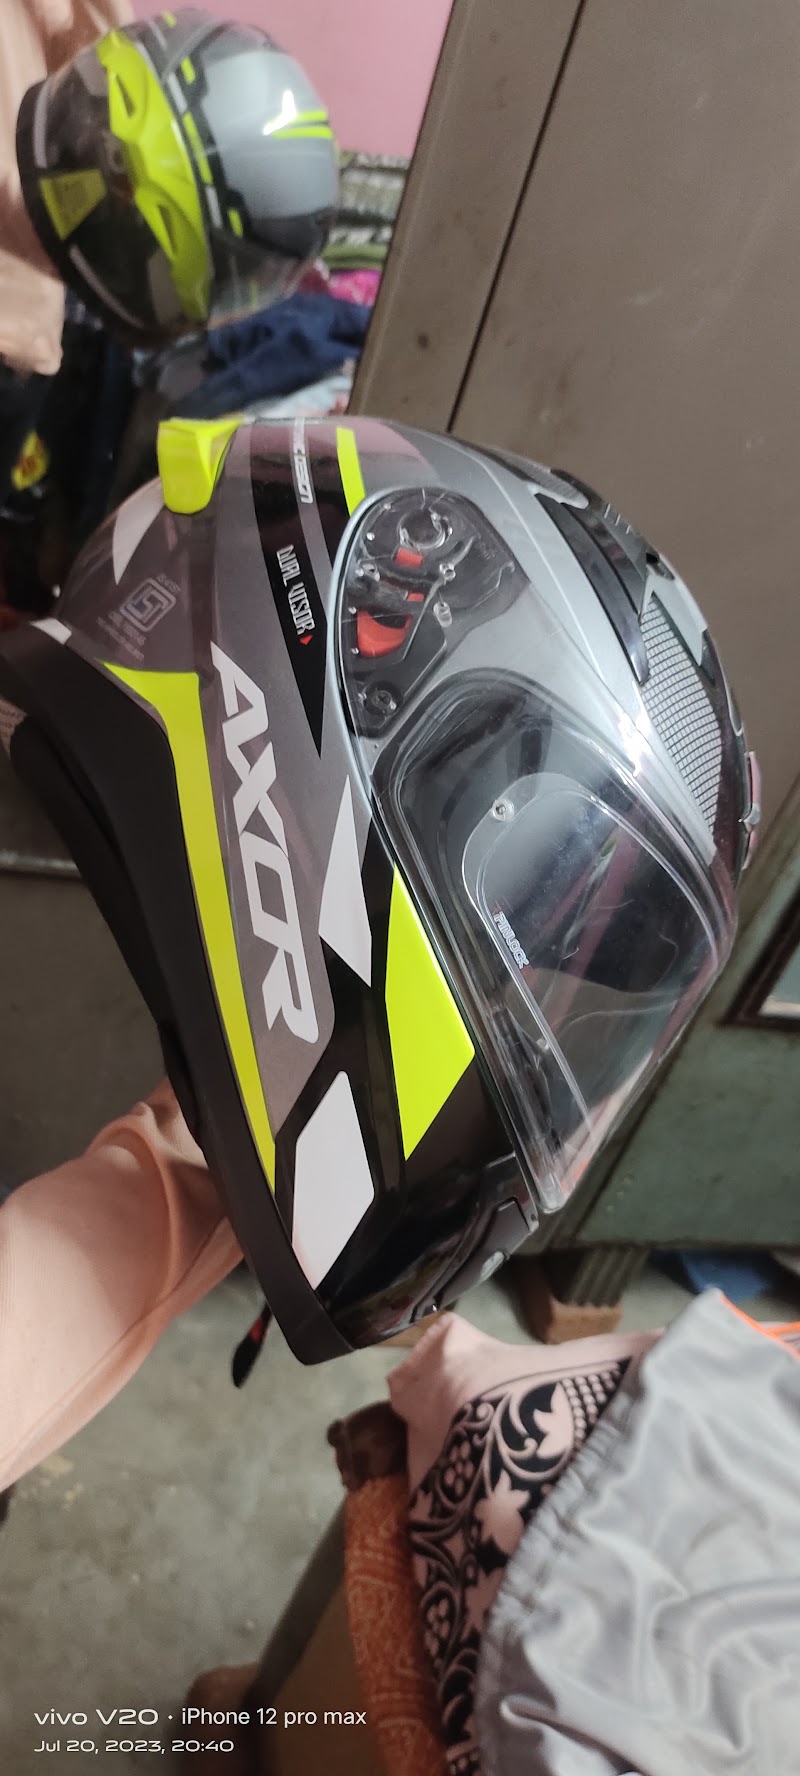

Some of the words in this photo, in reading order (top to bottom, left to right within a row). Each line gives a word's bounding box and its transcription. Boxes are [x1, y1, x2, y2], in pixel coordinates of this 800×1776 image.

[276, 544, 301, 587] DUAL
[287, 582, 316, 635] VISOR
[210, 640, 320, 1044] AXOR
[493, 910, 530, 970] PINLOCK
